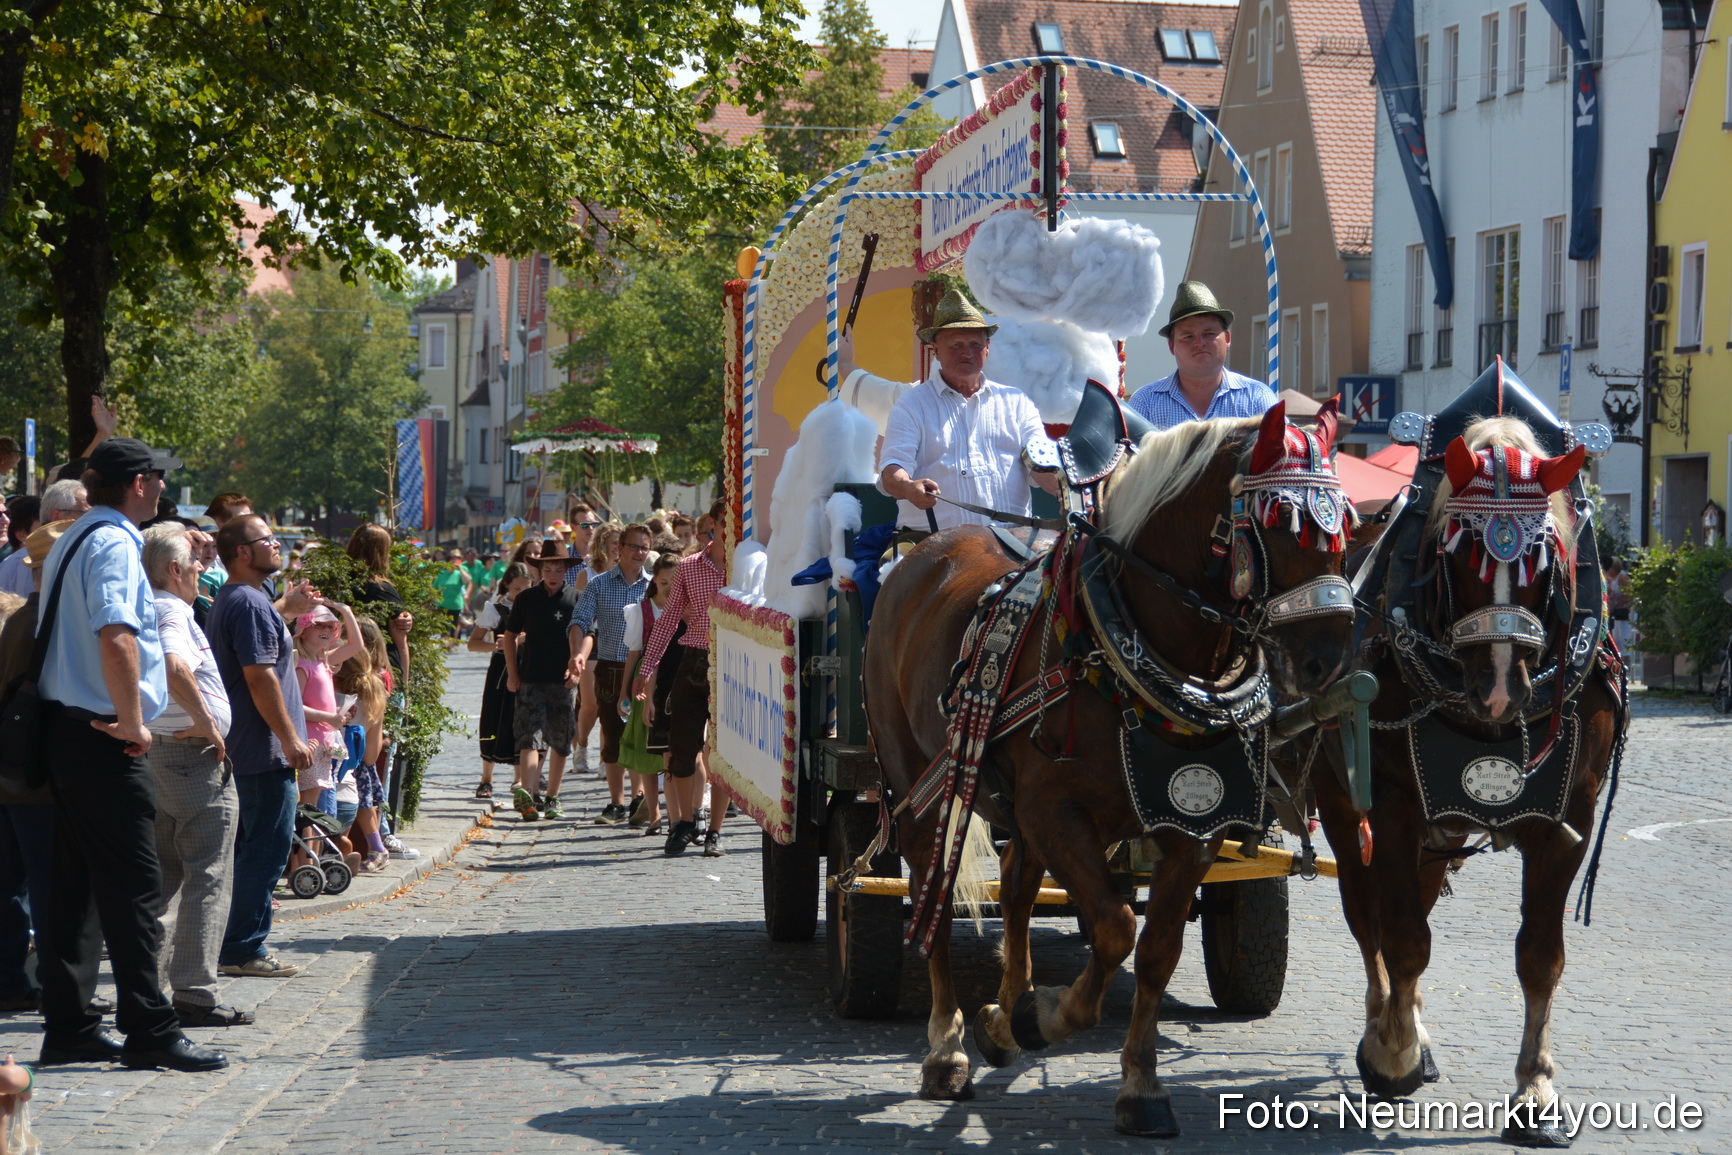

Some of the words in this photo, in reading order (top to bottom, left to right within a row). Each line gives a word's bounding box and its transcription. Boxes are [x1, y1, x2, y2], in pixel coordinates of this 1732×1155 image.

[1647, 245, 1669, 424] HOTEL
[1480, 783, 1507, 791] Ellingen
[1185, 792, 1209, 801] Ellingen
